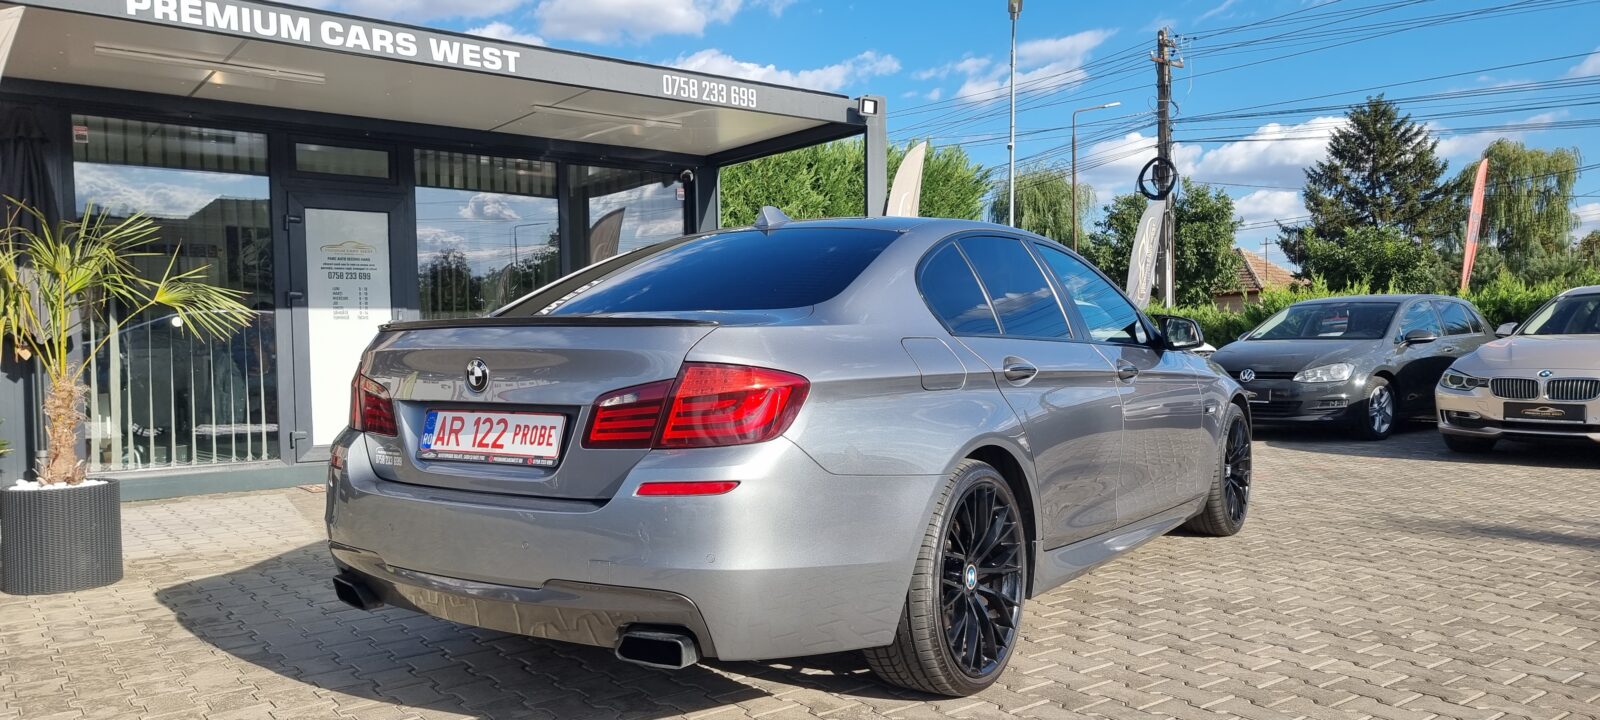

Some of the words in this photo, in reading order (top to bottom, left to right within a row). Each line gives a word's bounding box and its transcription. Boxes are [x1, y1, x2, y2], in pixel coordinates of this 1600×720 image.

[126, 0, 311, 42] PREMIUM
[320, 20, 418, 57] CARS
[428, 37, 521, 73] WEST
[662, 74, 698, 99] 0758
[702, 81, 727, 103] 233
[731, 86, 757, 108] 699
[328, 271, 344, 280] 0758
[345, 272, 357, 280] 233
[358, 272, 371, 280] 699
[422, 433, 433, 445] RO
[433, 415, 465, 447] AR
[472, 416, 509, 449] 122
[512, 423, 557, 447] PROBE
